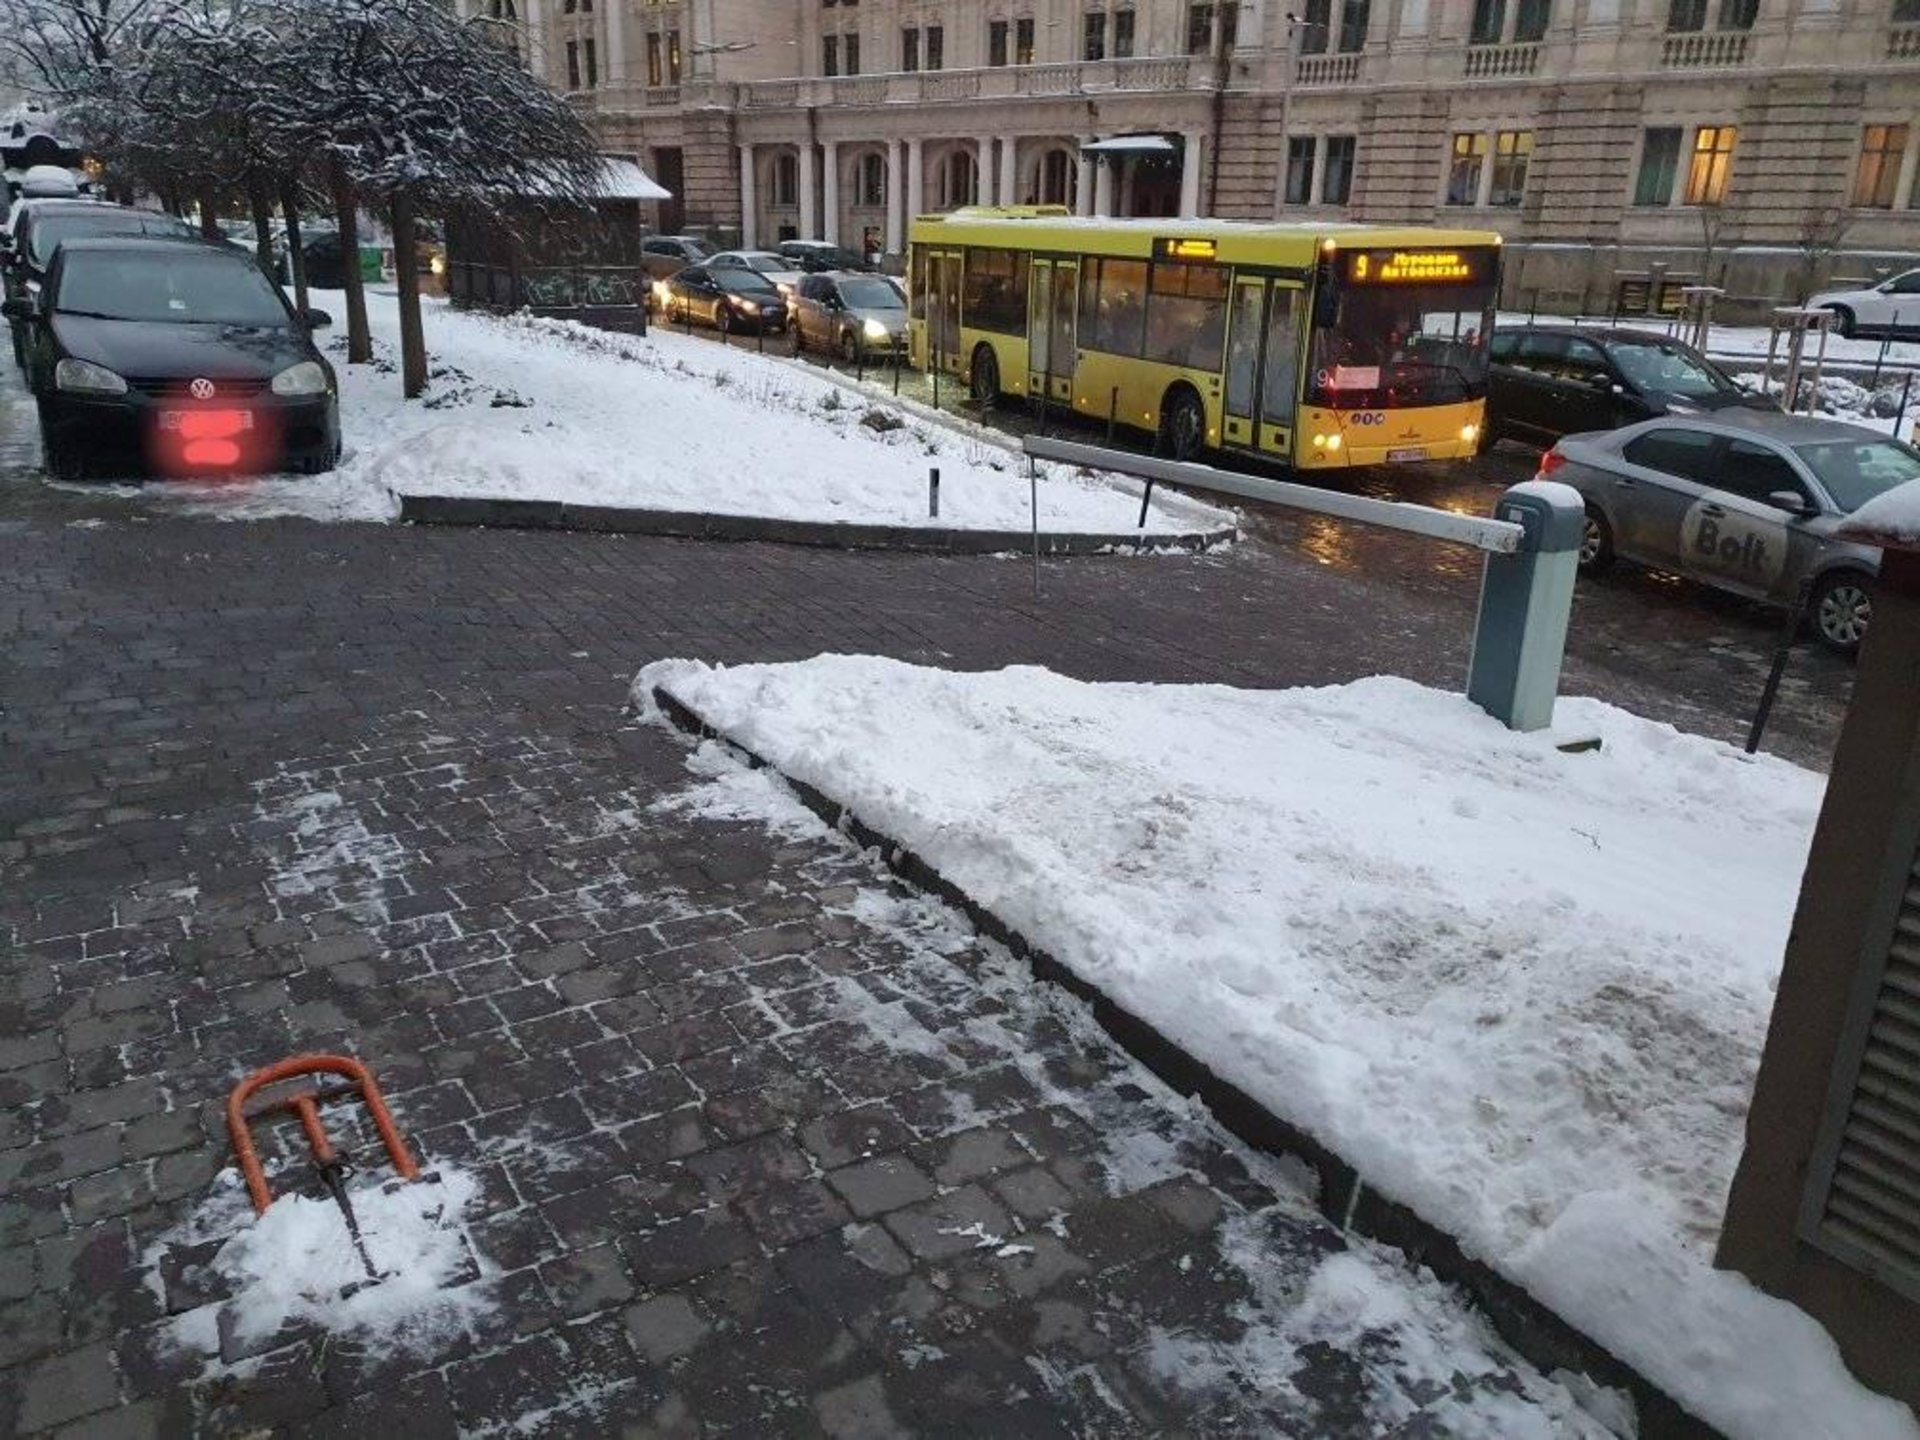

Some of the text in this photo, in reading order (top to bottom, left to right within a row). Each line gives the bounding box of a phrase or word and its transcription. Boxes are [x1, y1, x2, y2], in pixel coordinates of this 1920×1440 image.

[1356, 254, 1368, 278] 9
[1317, 368, 1329, 388] 9
[1698, 518, 1770, 573] Bolt
